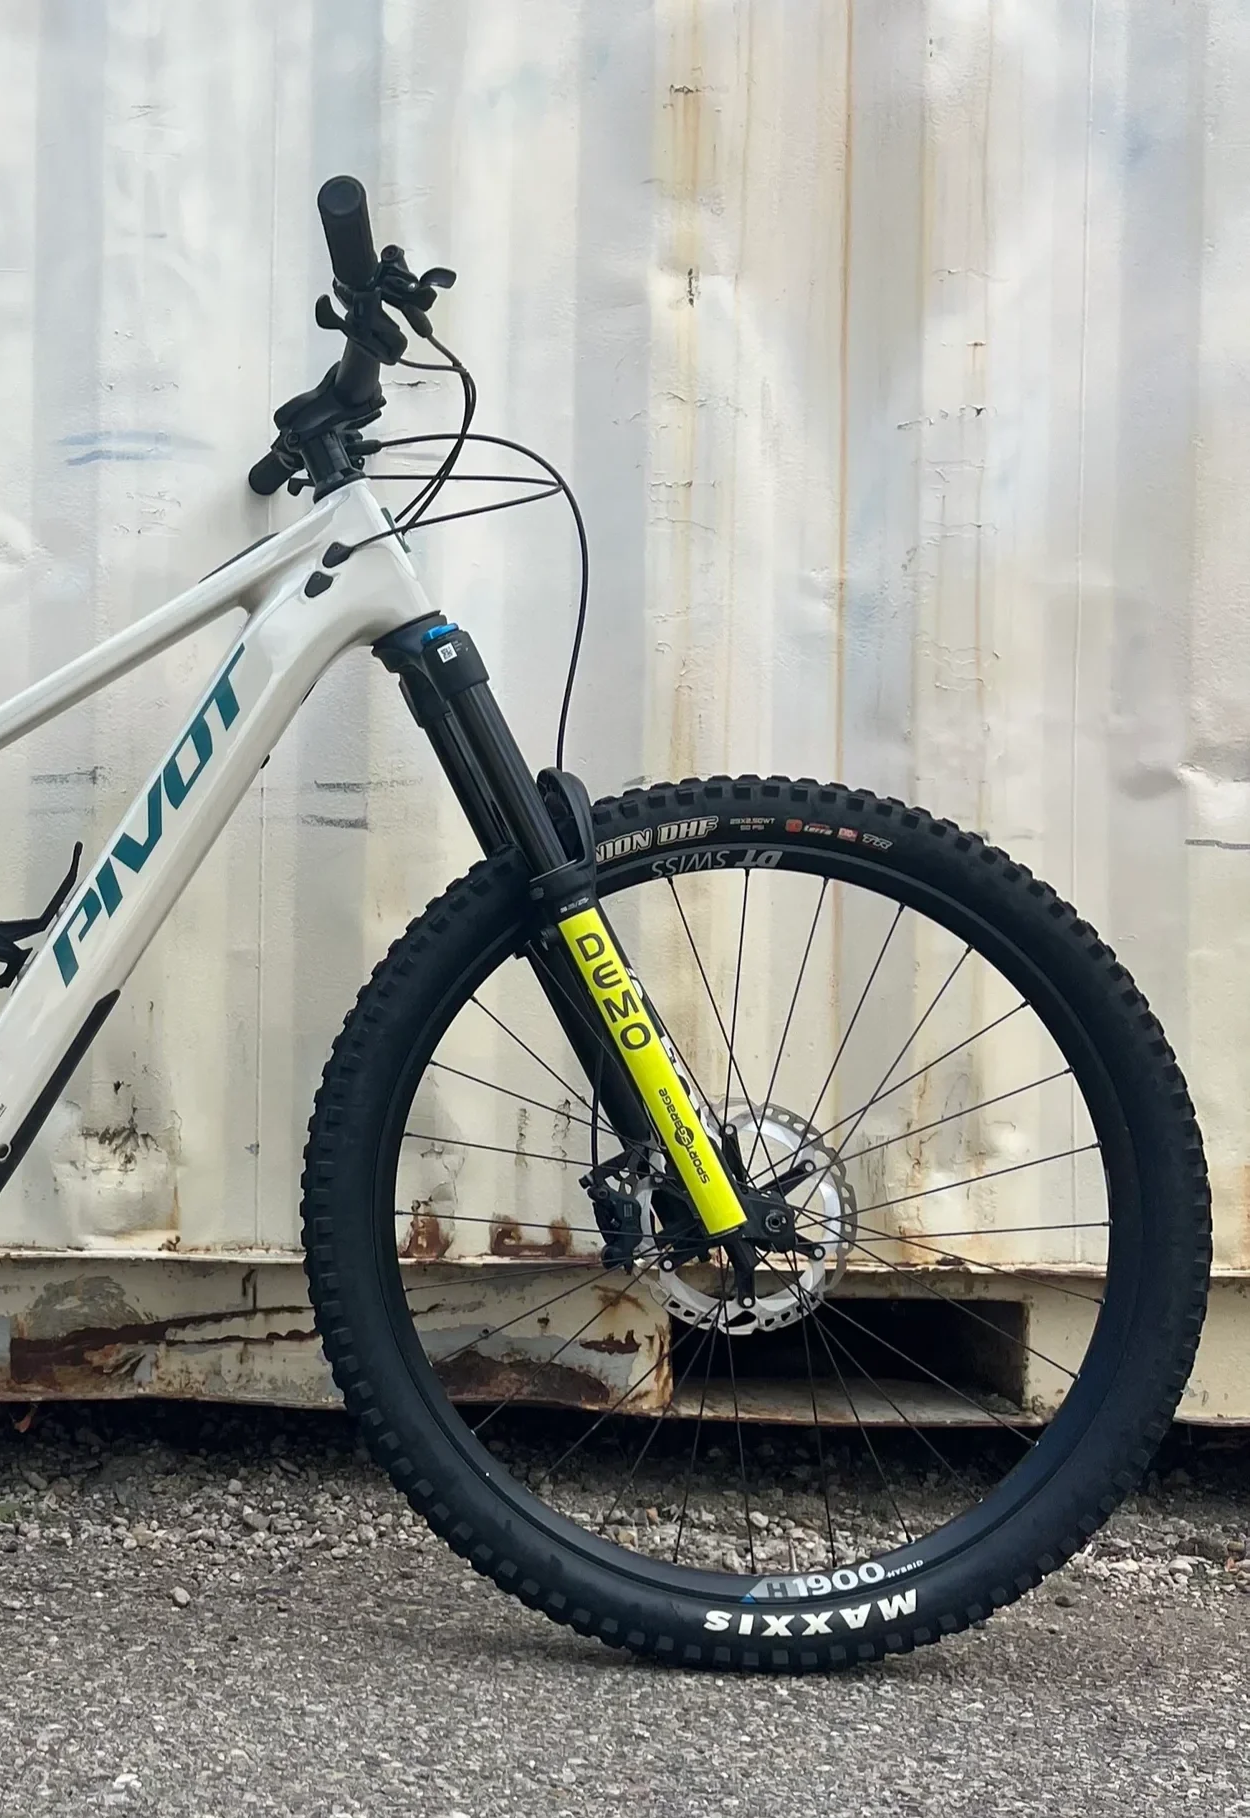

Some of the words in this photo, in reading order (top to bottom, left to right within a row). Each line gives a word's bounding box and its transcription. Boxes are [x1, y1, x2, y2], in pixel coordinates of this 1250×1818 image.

[53, 642, 245, 988] PIVOT
[803, 825, 834, 837] terra
[595, 827, 654, 865] NION
[658, 816, 719, 845] DHF
[733, 849, 784, 869] DT
[651, 850, 730, 879] SWISS
[575, 933, 652, 1051] DEMO
[766, 1562, 886, 1598] H1900
[886, 1559, 925, 1579] HYBRID
[703, 1588, 918, 1637] MAXXIS
